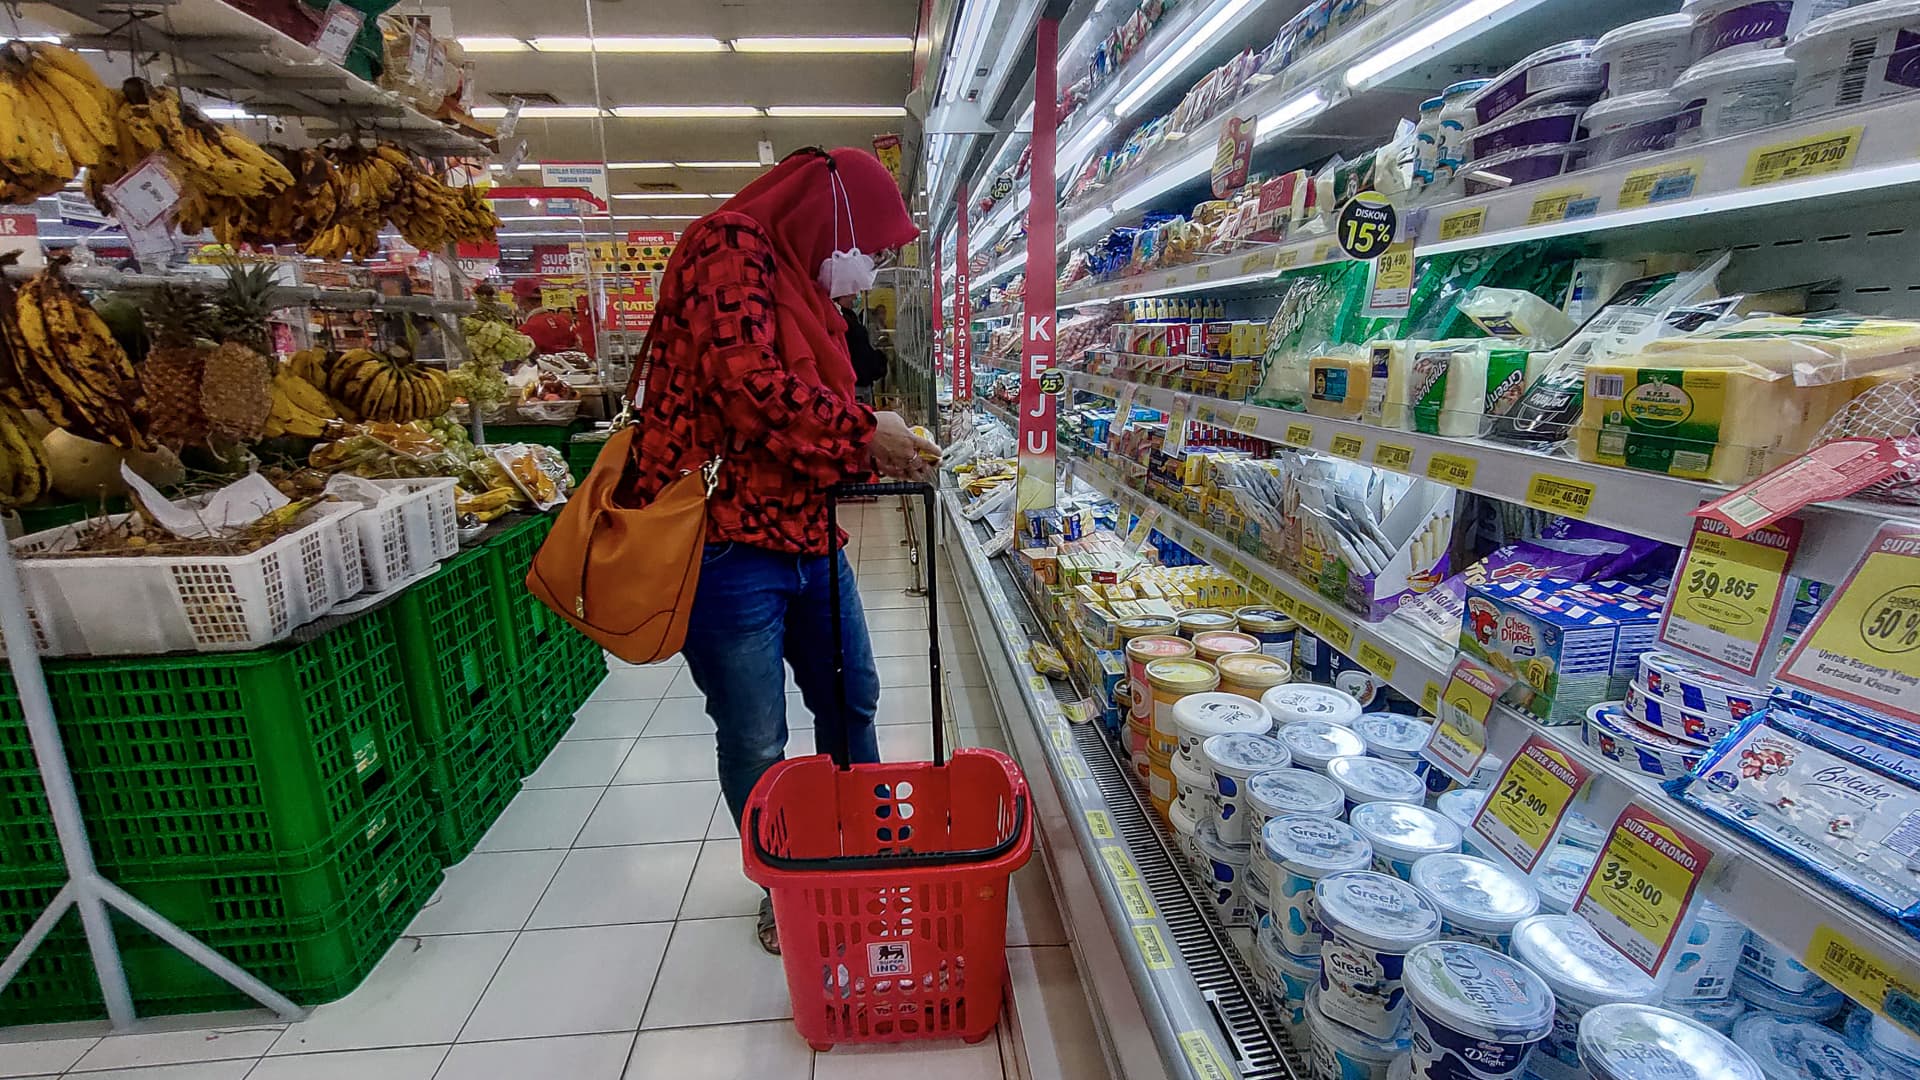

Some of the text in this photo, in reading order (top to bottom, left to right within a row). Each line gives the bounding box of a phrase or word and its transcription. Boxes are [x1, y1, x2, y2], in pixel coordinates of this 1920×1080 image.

[1799, 146, 1847, 167] 29.290
[1355, 208, 1387, 221] DISKON
[1346, 219, 1390, 253] 15%
[541, 253, 573, 265] SUPE
[613, 301, 655, 311] GRATIS
[1027, 316, 1051, 454] KEJU
[1560, 489, 1588, 506] 46.490
[1701, 518, 1791, 549] SUPE ROMO!
[1881, 538, 1920, 554] SUPE
[1687, 569, 1759, 600] 39.865
[1501, 626, 1536, 647] Dippers
[1504, 616, 1531, 636] Cheez
[1867, 607, 1902, 639] 50
[1816, 663, 1863, 684] Bertanda
[1817, 649, 1847, 666] Untuk
[1848, 655, 1889, 677] Barang
[1525, 745, 1549, 765] SUPER
[1547, 760, 1579, 788] PROMO!
[1812, 766, 1890, 801] Belcube
[1501, 780, 1548, 817] 25.900
[1289, 825, 1338, 840] Greek
[1623, 817, 1653, 843] SUPER
[1653, 837, 1699, 871] PROMO!
[1346, 884, 1401, 906] Greek
[1602, 861, 1663, 907] 33.900
[876, 964, 906, 973] INDO
[1329, 952, 1374, 979] Greek
[1443, 954, 1498, 1015] Delight
[1464, 1047, 1506, 1067] Delight
[1821, 1043, 1860, 1080] Gree
